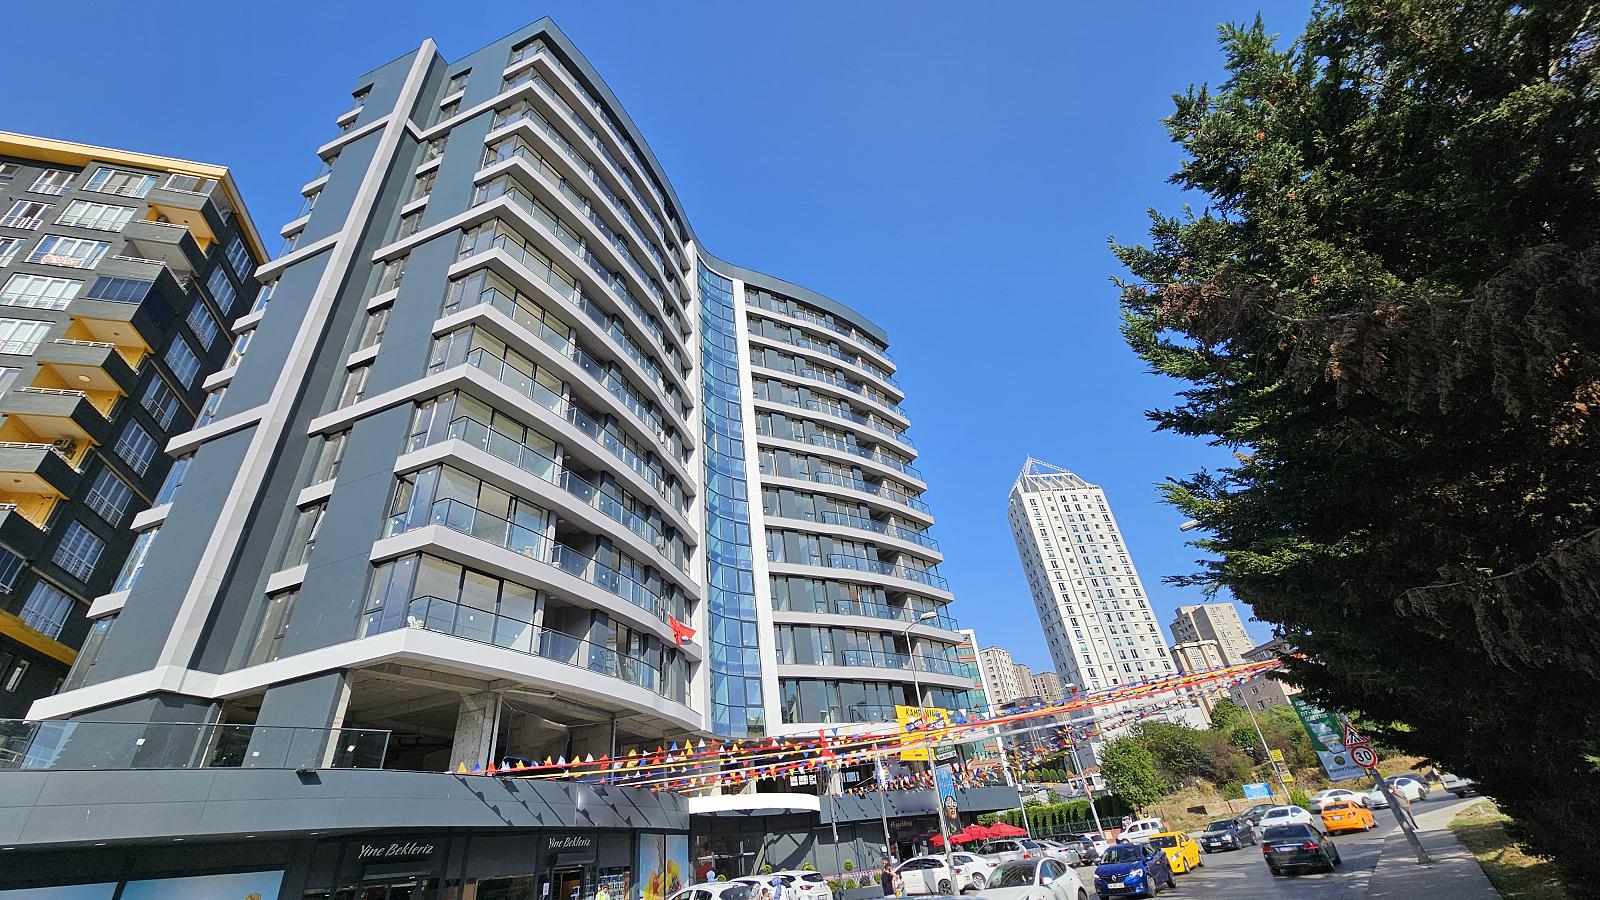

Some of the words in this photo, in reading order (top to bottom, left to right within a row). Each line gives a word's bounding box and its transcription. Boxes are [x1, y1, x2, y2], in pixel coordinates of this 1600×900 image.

[1355, 750, 1372, 762] 30
[547, 837, 563, 850] Yine
[563, 836, 591, 848] Bekleriz
[358, 844, 385, 859] Yine
[385, 842, 434, 858] Bekleriz
